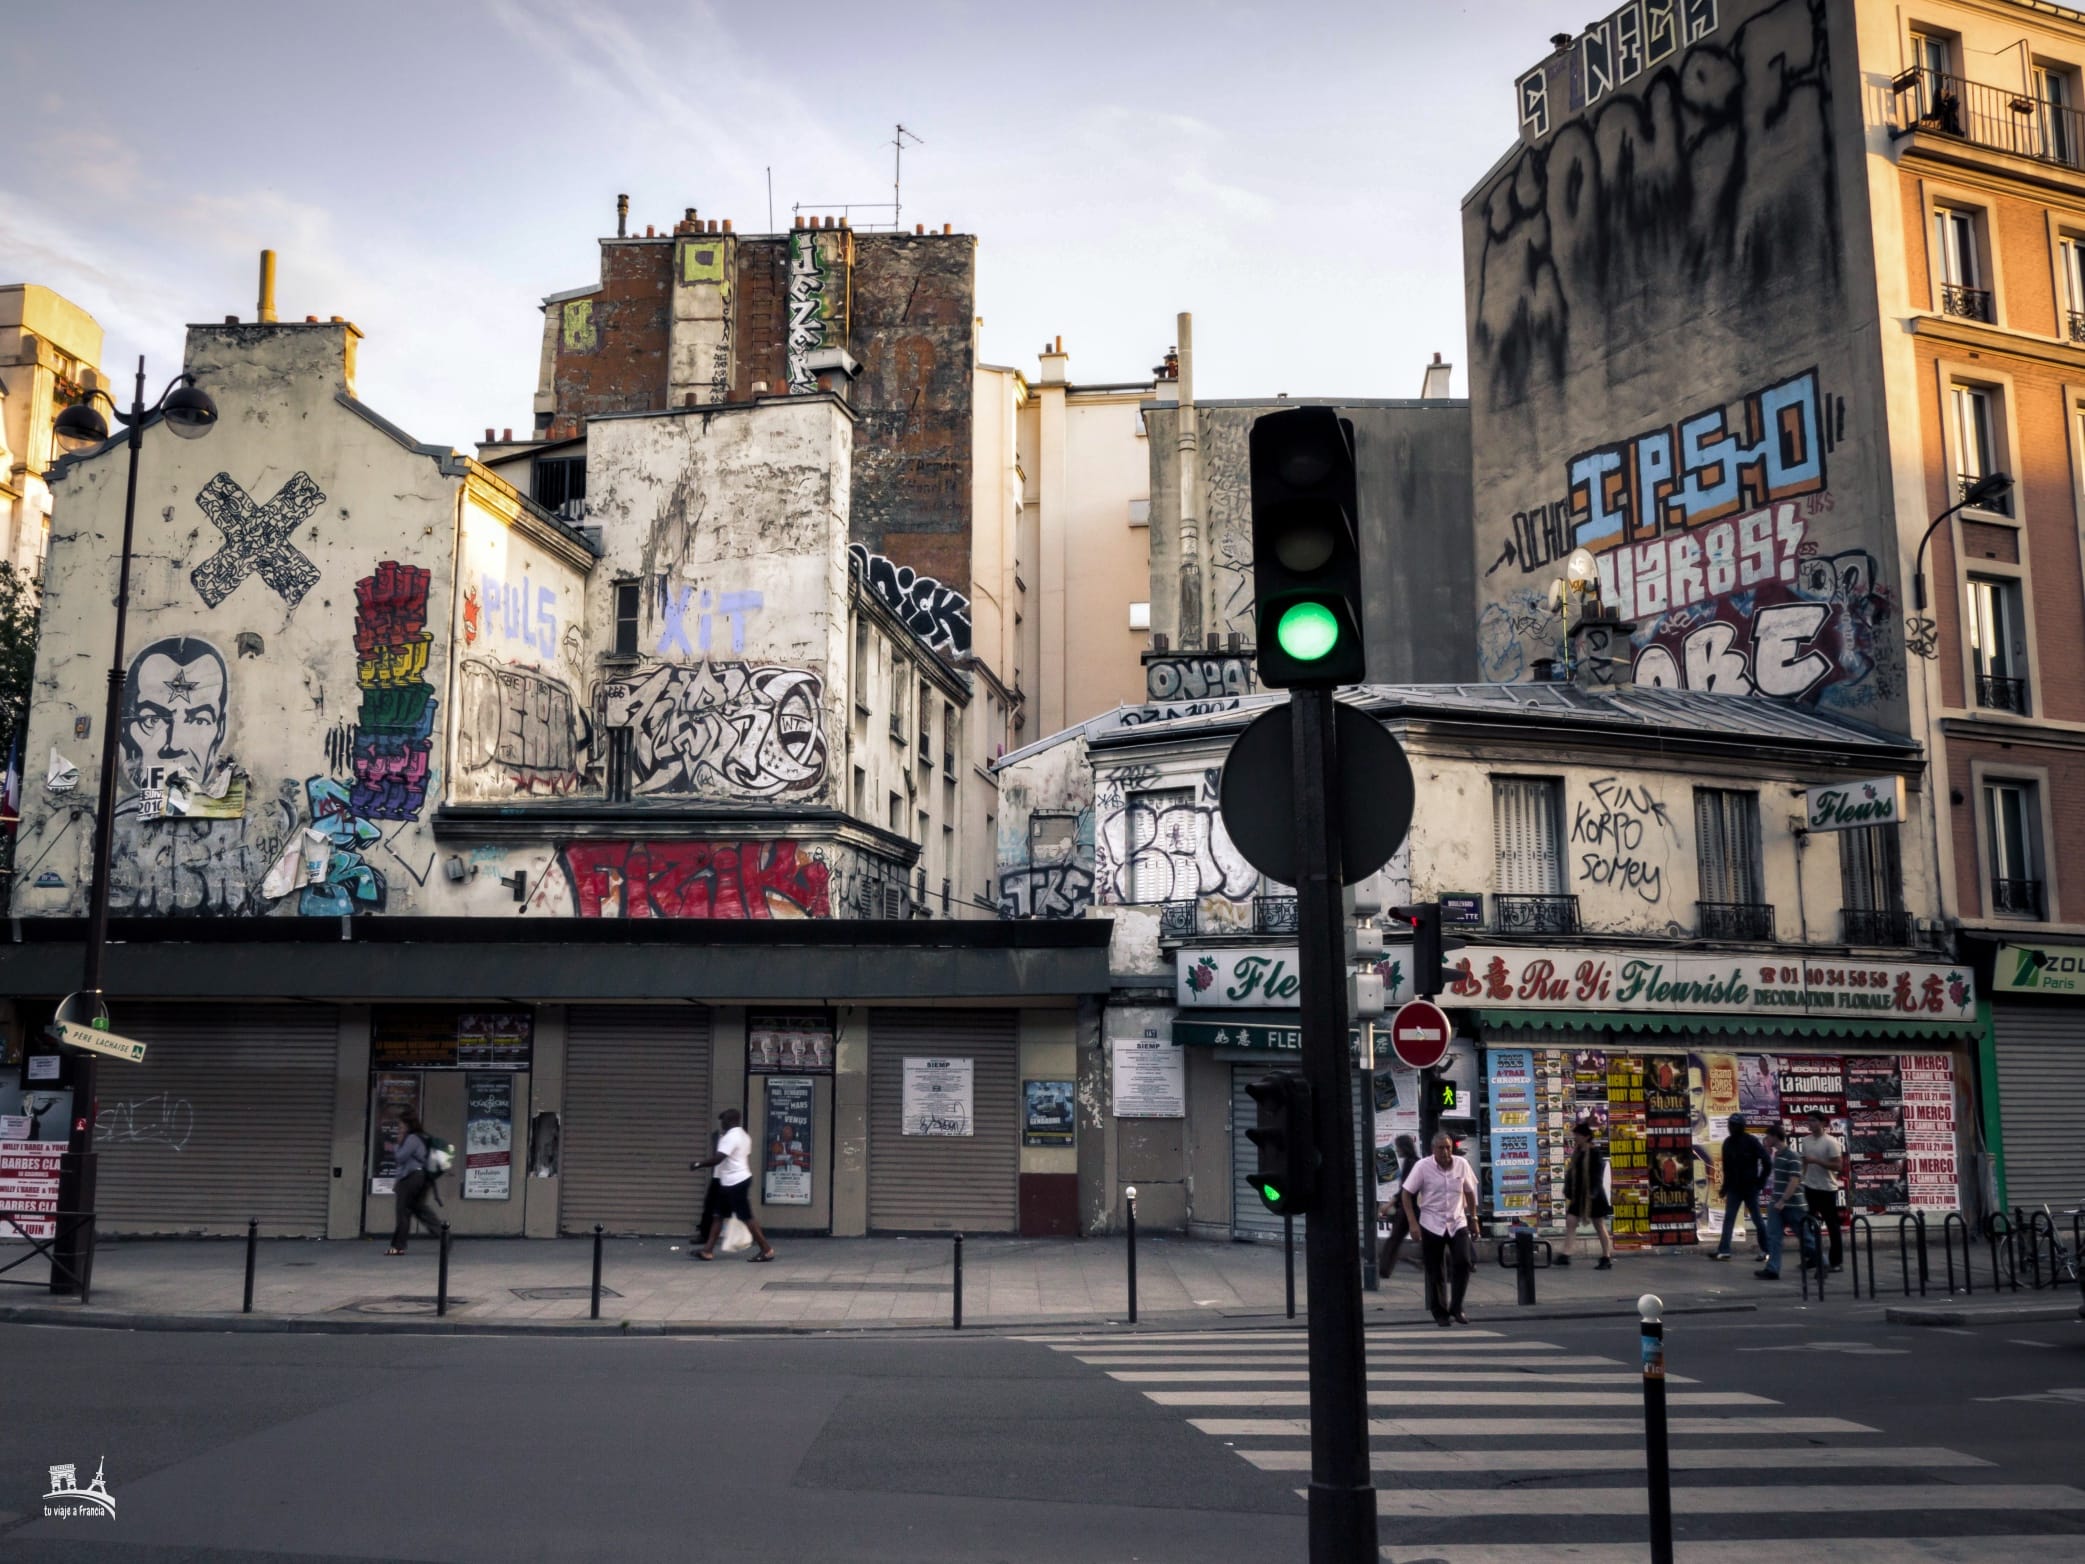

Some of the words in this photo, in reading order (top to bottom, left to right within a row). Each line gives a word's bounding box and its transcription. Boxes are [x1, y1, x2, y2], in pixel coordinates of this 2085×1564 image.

[1810, 790, 1894, 828] Fleurs
[1227, 956, 1300, 1001] Fle
[1518, 958, 1571, 1001] Ru
[1575, 959, 1613, 1002] Yi
[1616, 959, 1750, 1005] Fleuriste
[1779, 966, 1799, 985] 01
[2042, 977, 2075, 990] Paris
[1753, 988, 1836, 1008] DECORATION
[1838, 991, 1893, 1011] FLORALE
[1893, 971, 1945, 1013] 花店
[95, 1036, 130, 1053] LACHAISE
[1901, 1056, 1912, 1070] DJ
[1914, 1056, 1949, 1070] MERCO
[1790, 1105, 1802, 1114] LA
[1803, 1105, 1836, 1114] CIGALE
[1904, 1106, 1914, 1120] DJ
[1916, 1106, 1952, 1120] MERCO
[2, 1157, 40, 1170] BARBES
[42, 1157, 61, 1170] CLA
[1919, 1158, 1954, 1173] MERCO
[38, 1200, 57, 1212] CLA
[25, 1224, 44, 1235] JUIN
